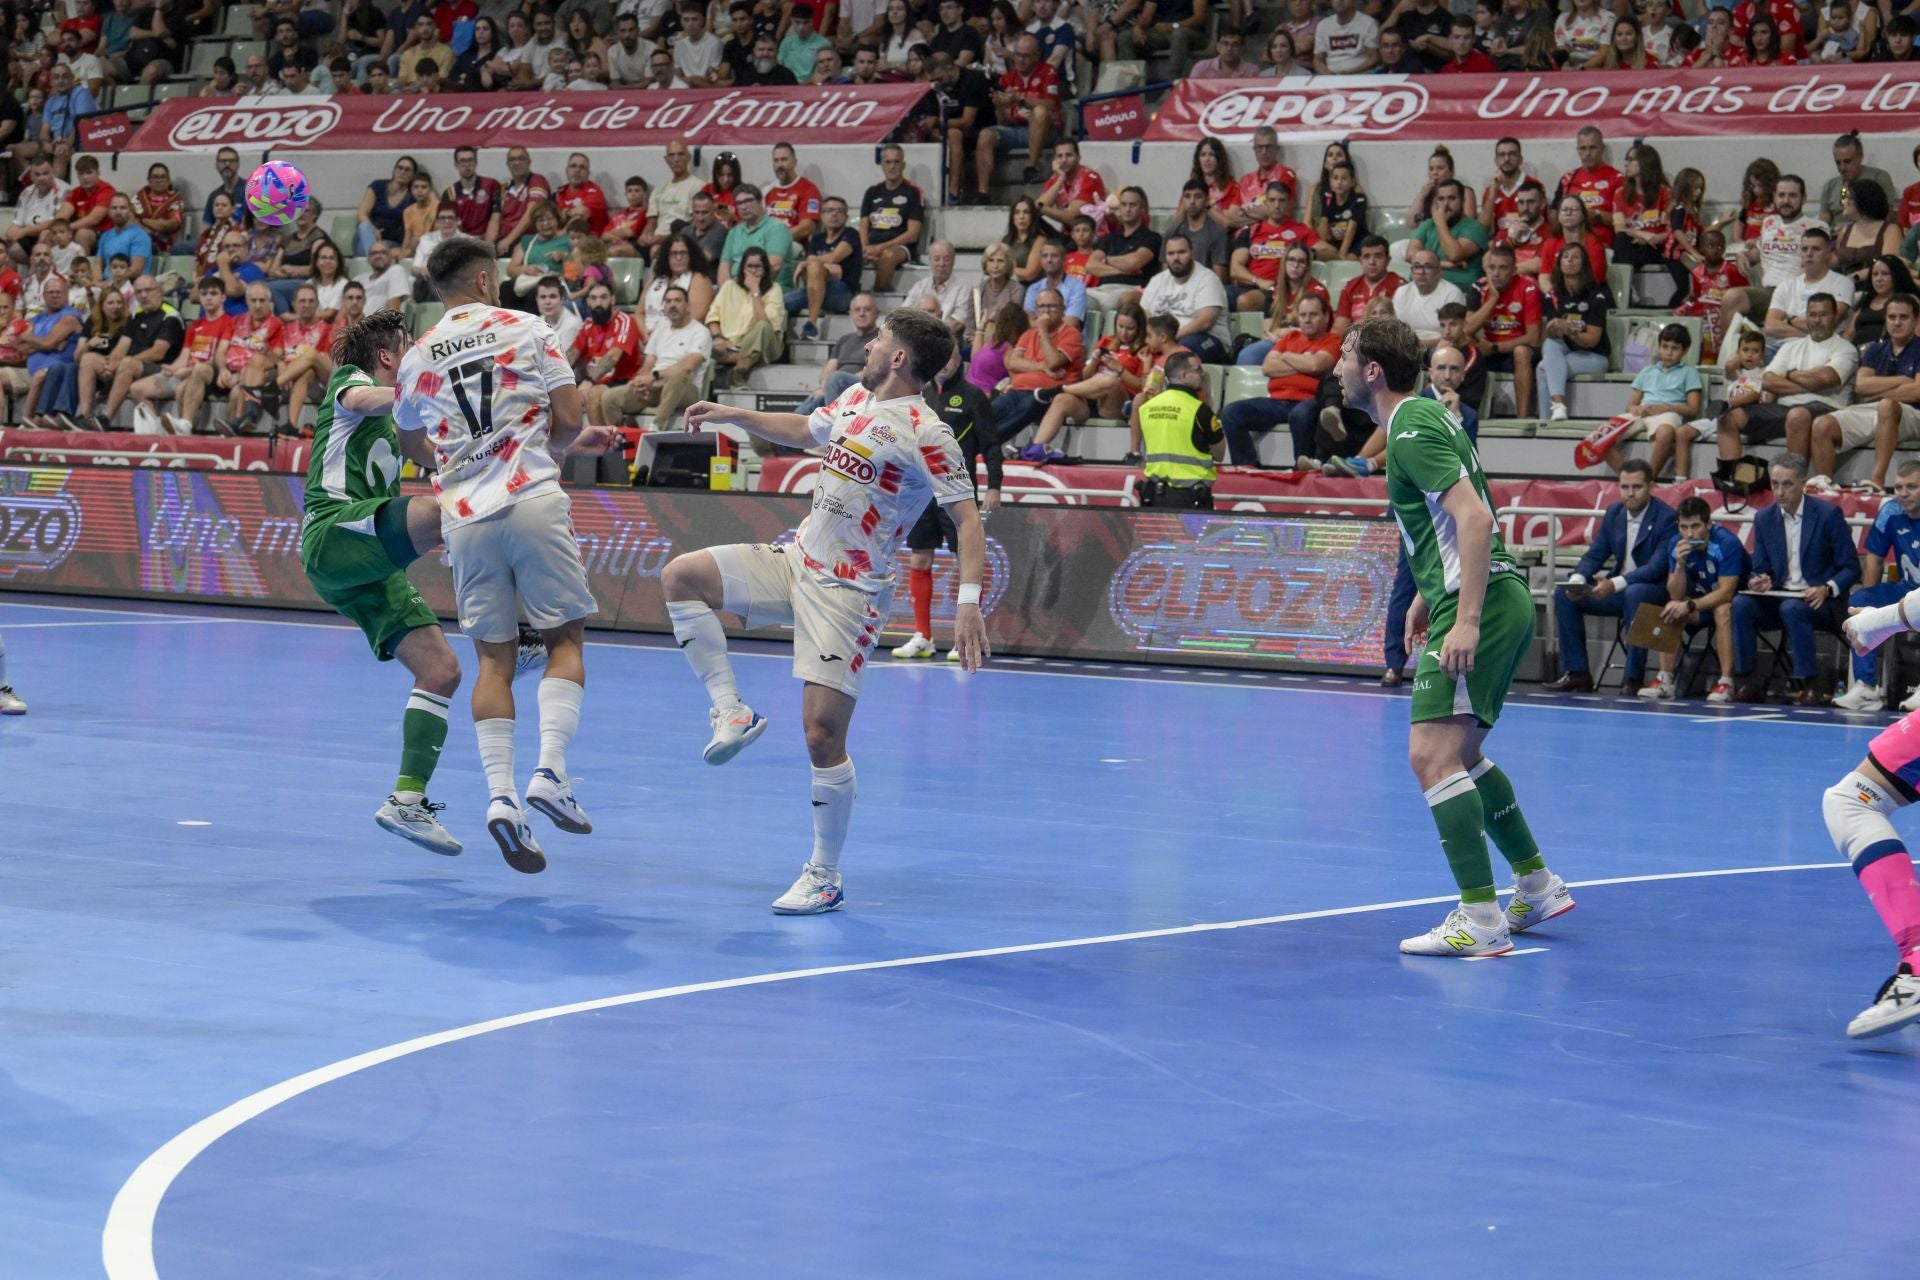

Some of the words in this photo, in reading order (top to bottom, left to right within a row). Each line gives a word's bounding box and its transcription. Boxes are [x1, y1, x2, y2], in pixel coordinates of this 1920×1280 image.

[372, 98, 472, 132] Uno
[475, 99, 573, 131] más
[579, 99, 640, 130] de
[645, 98, 694, 129] la
[683, 90, 879, 138] familia
[1477, 77, 1609, 119] Uno
[1621, 75, 1752, 116] más
[1768, 75, 1848, 112] de
[1860, 73, 1920, 112] la
[431, 331, 497, 361] Rivera
[448, 355, 494, 440] 17
